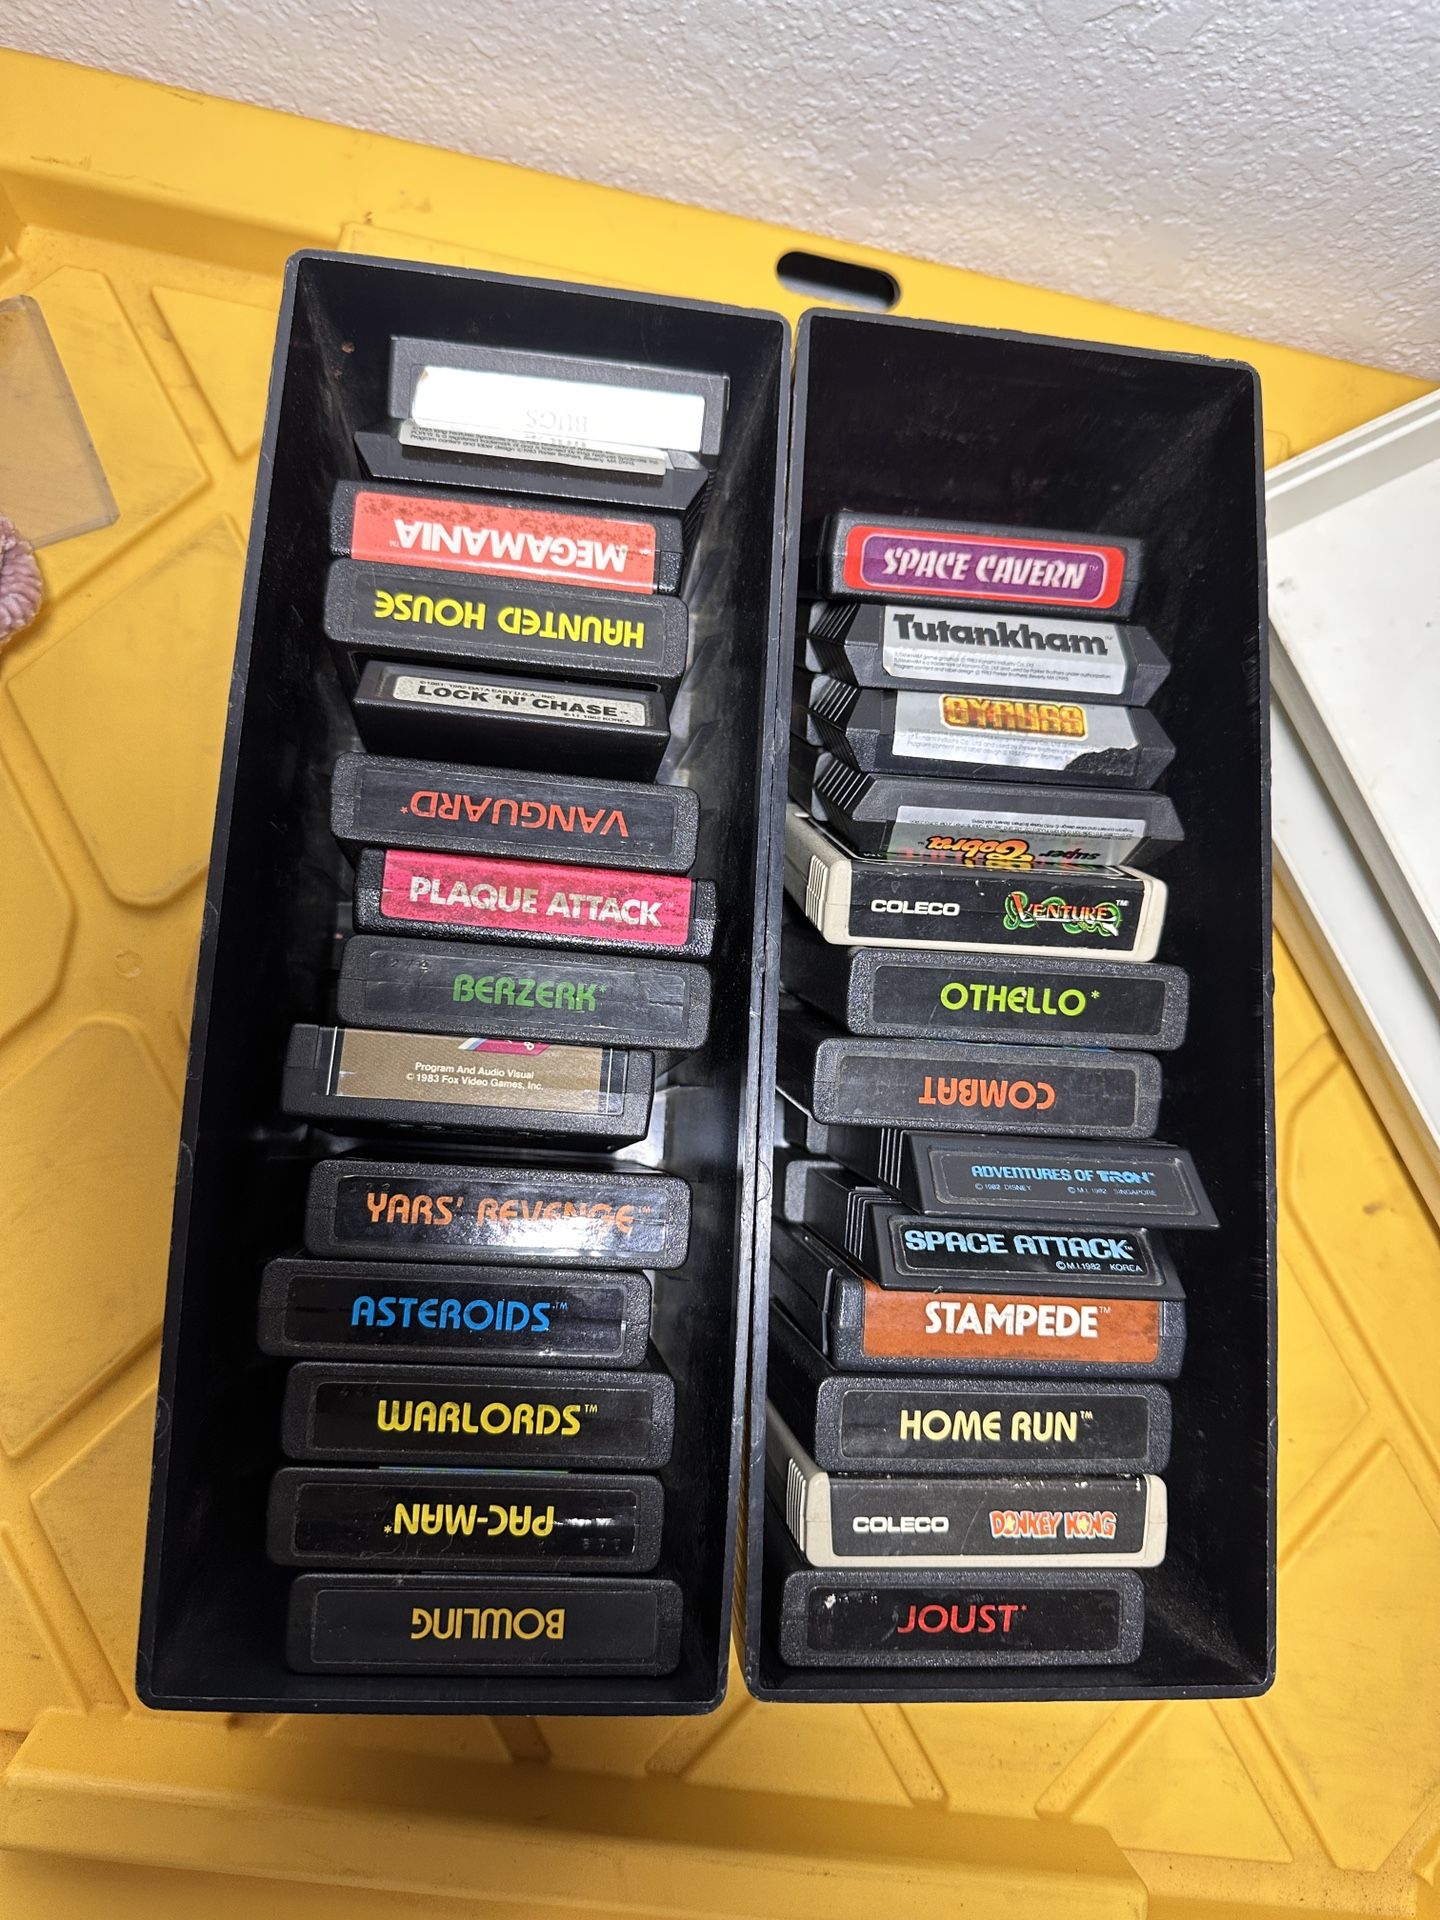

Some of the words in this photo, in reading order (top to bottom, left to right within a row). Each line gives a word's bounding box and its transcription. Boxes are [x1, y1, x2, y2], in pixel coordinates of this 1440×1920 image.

[882, 547, 972, 581] SPACE
[374, 590, 486, 630] HOUSE
[498, 608, 645, 649] HAUNTED
[417, 685, 490, 701] LOCK
[494, 694, 526, 706] 'N'
[1038, 848, 1101, 860] super
[409, 876, 539, 914] PLAQUE
[871, 898, 960, 917] COLECO
[414, 1061, 454, 1074] Program
[456, 1065, 475, 1075] And
[477, 1067, 505, 1077] Audio
[506, 1069, 534, 1079] Visual
[441, 1074, 459, 1084] Fox
[461, 1076, 488, 1086] Video
[489, 1078, 524, 1089] Games,
[527, 1081, 543, 1091] Inc.
[918, 1075, 1056, 1111] COMBAT
[971, 1165, 1072, 1182] ADVENTURES
[1074, 1169, 1094, 1183] OF
[366, 1192, 463, 1226] YARS'
[905, 1229, 1009, 1255] SPACE
[1109, 1263, 1143, 1273] KOREA
[901, 1409, 1002, 1441] HOME
[852, 1515, 950, 1534] COLECO
[988, 1510, 1063, 1540] DONKEY
[1063, 1510, 1118, 1540] KONG
[411, 1607, 566, 1640] BOWLING
